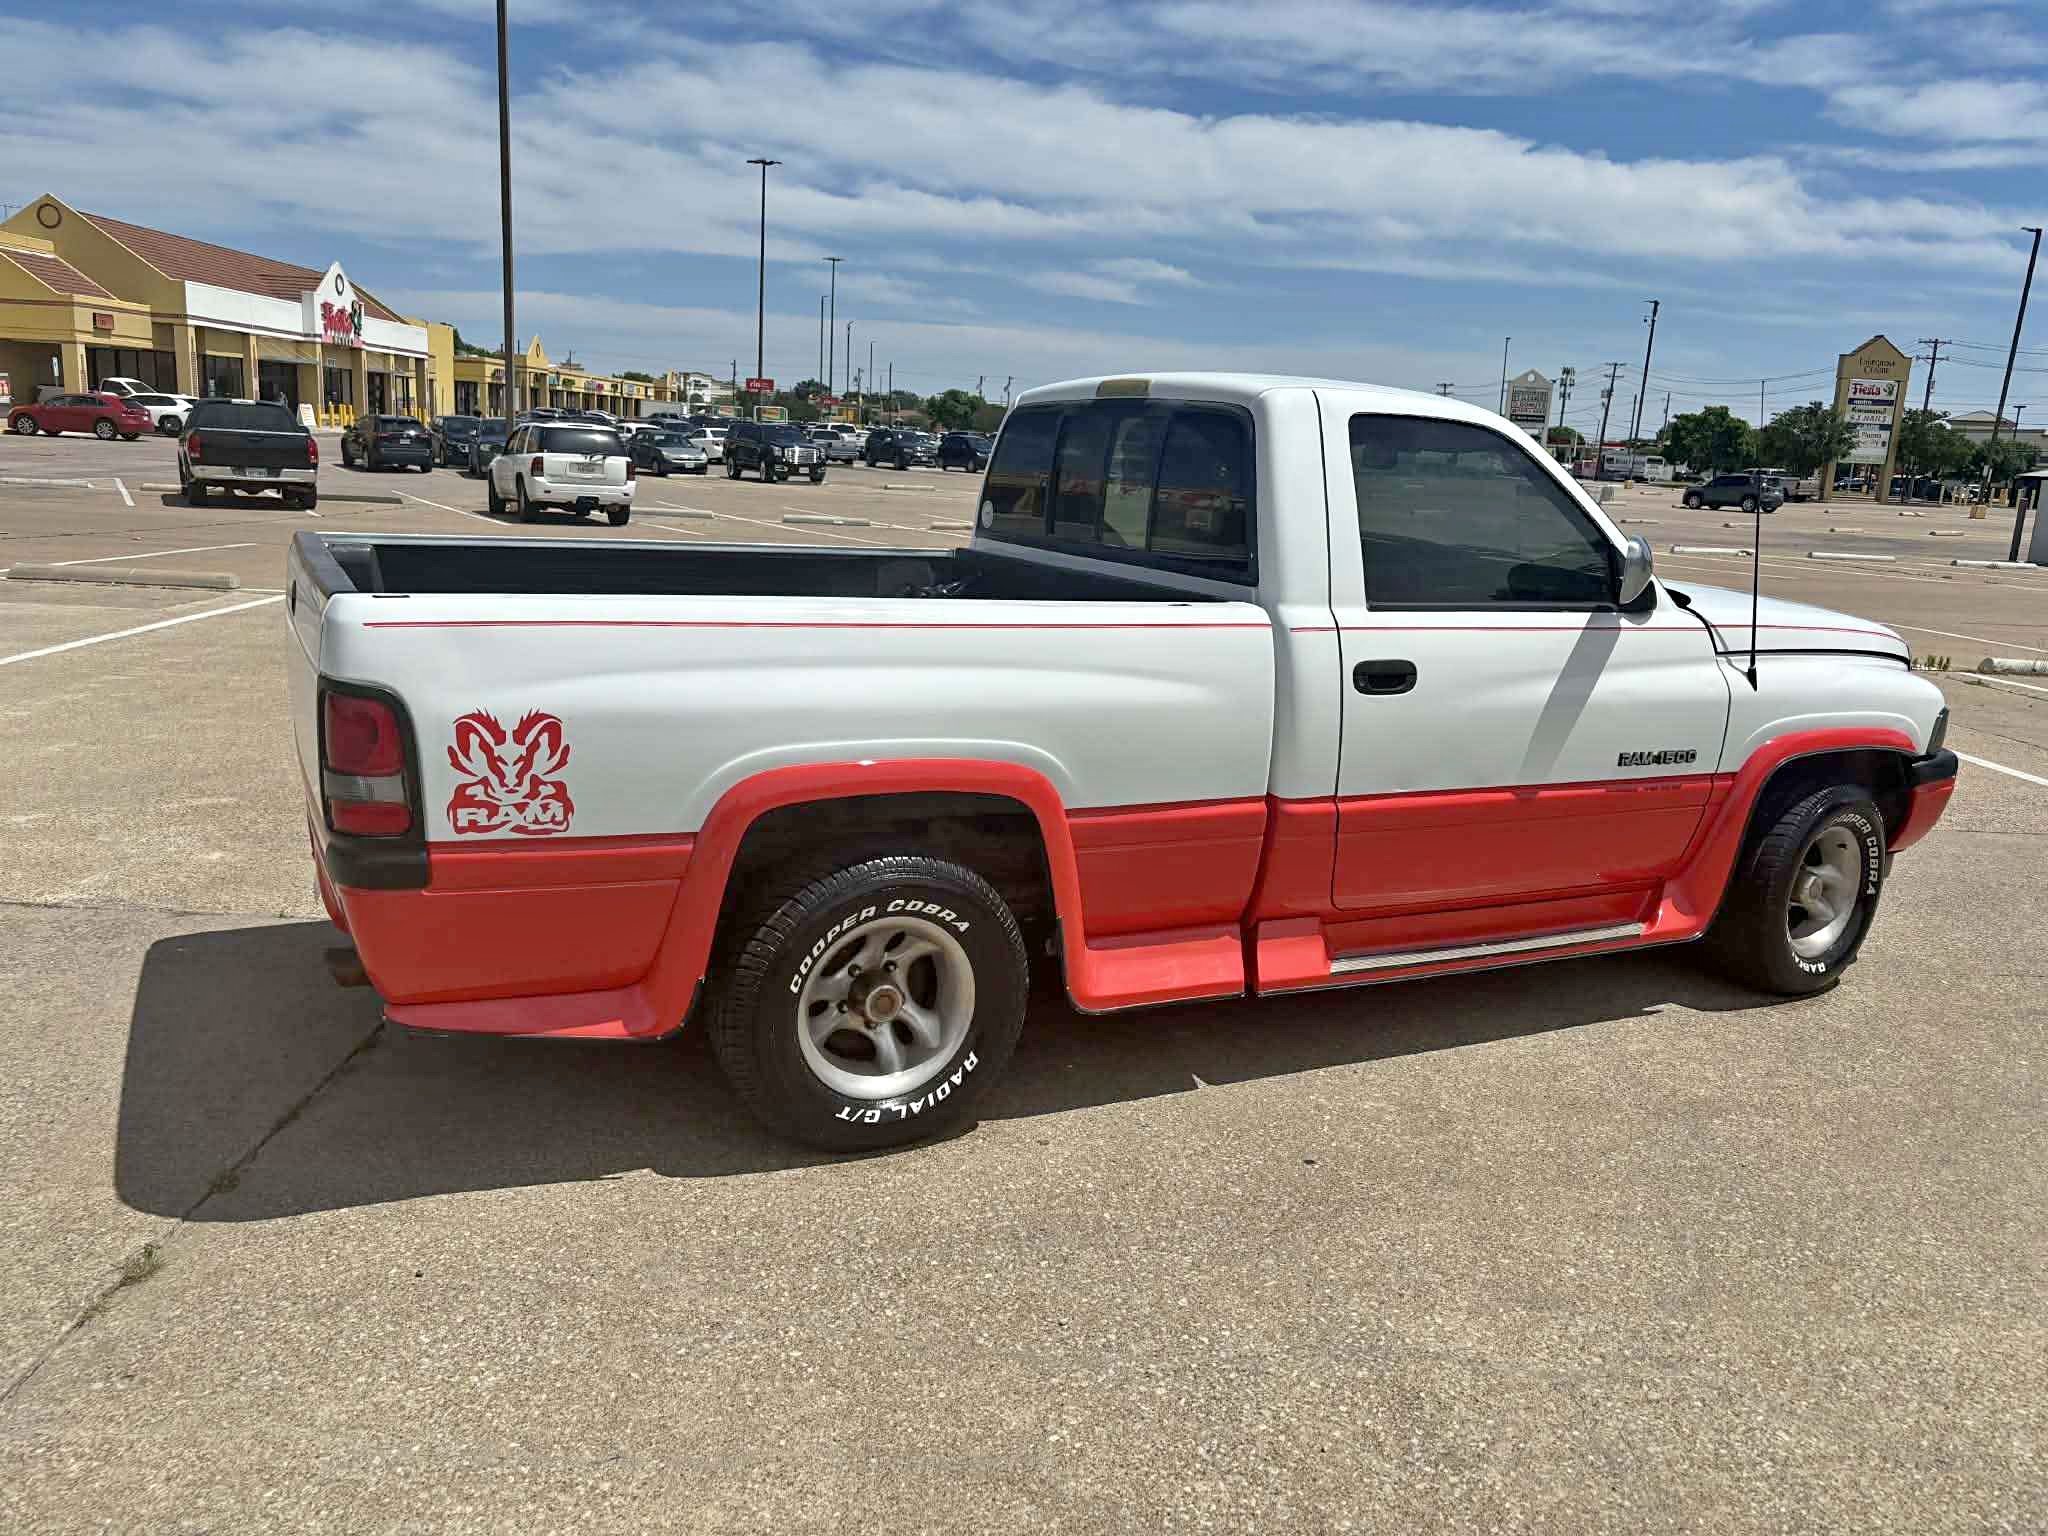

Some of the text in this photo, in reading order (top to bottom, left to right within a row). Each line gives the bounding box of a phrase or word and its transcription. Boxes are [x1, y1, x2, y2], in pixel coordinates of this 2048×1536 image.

[1617, 751, 1652, 767] RAM
[456, 800, 564, 828] RAM
[1866, 836, 1879, 895] COBRA
[789, 899, 970, 994] COOPER COBRA
[890, 1050, 979, 1119] RADIAL
